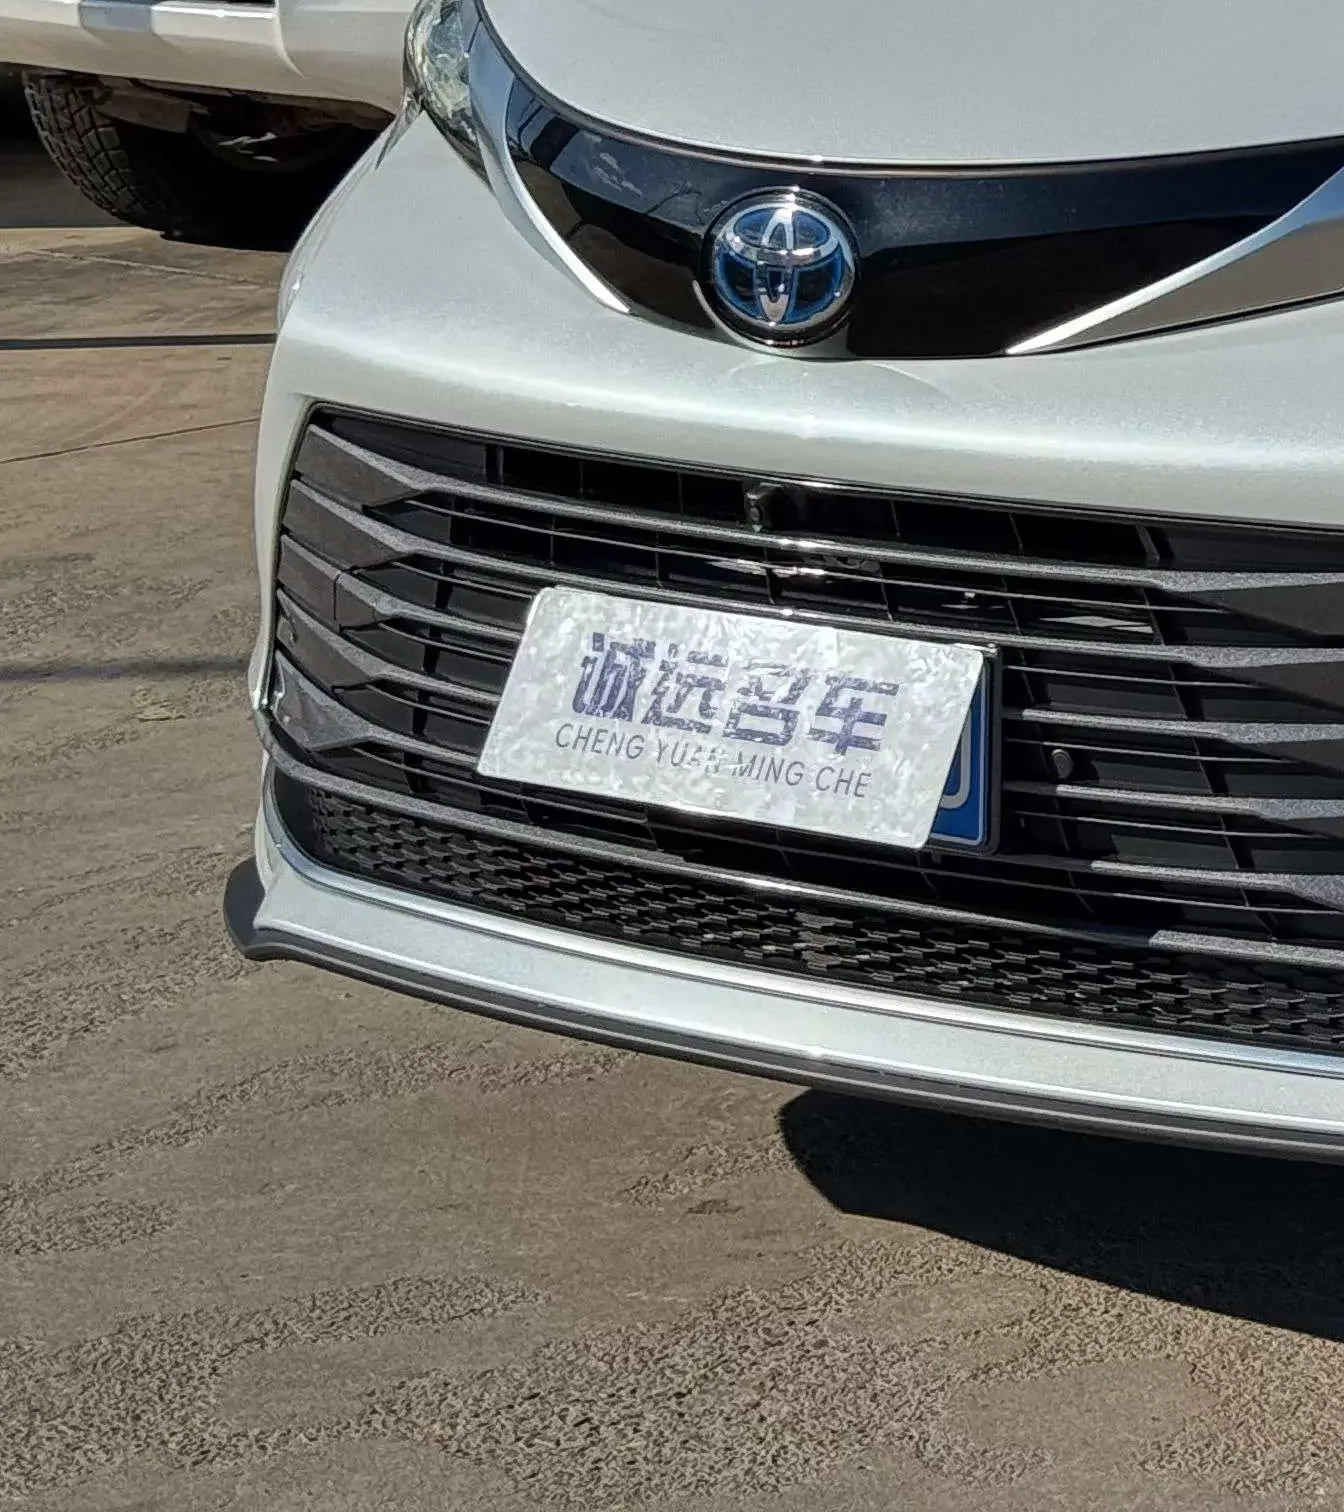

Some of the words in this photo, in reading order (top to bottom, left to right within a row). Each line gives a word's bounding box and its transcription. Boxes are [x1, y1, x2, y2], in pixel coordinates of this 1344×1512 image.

[571, 631, 898, 755] 诚远名车
[556, 723, 645, 760] CHENG
[733, 751, 805, 787] MING
[815, 766, 873, 799] CHE
